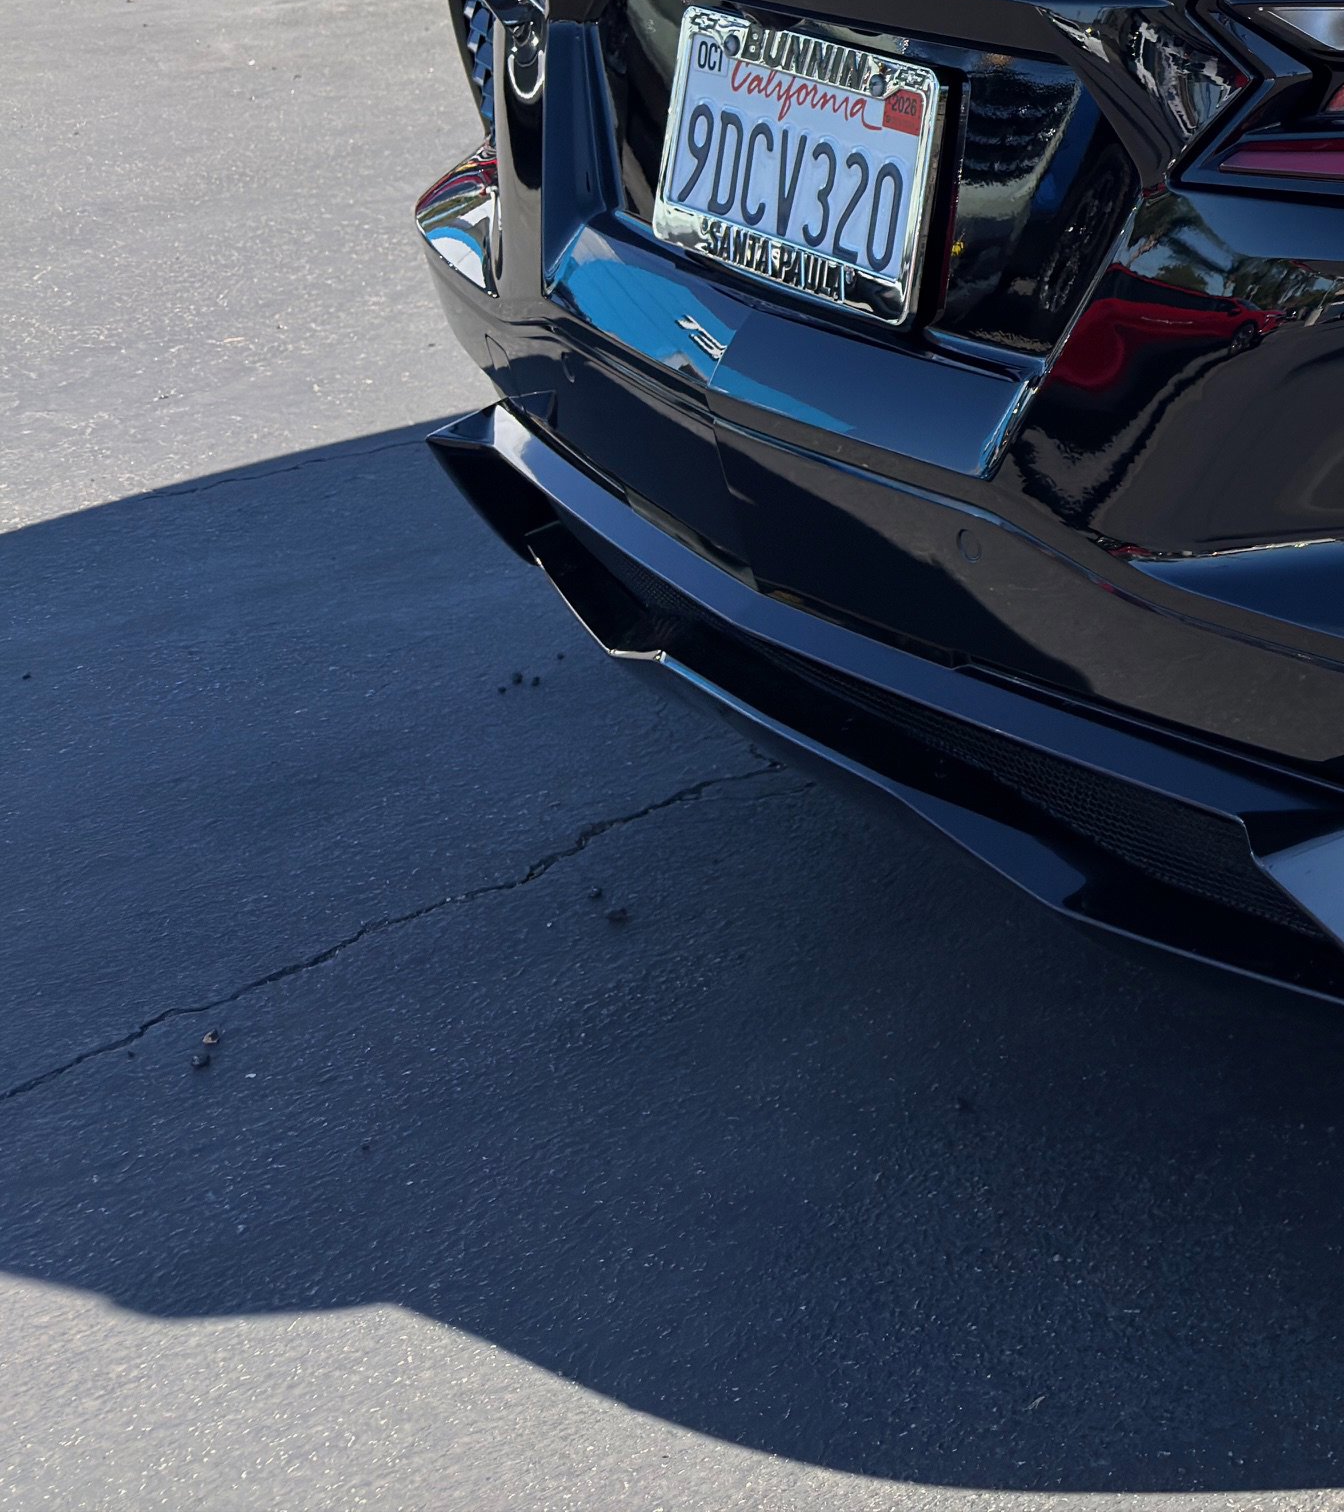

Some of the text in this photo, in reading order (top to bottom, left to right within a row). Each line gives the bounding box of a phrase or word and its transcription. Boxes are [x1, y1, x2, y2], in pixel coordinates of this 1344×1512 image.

[697, 40, 723, 72] OCT
[741, 24, 869, 90] BUNNIN
[731, 60, 882, 130] California
[891, 95, 917, 116] 2026
[677, 102, 904, 272] 9DCV320
[706, 220, 845, 303] SANTA PAULA
